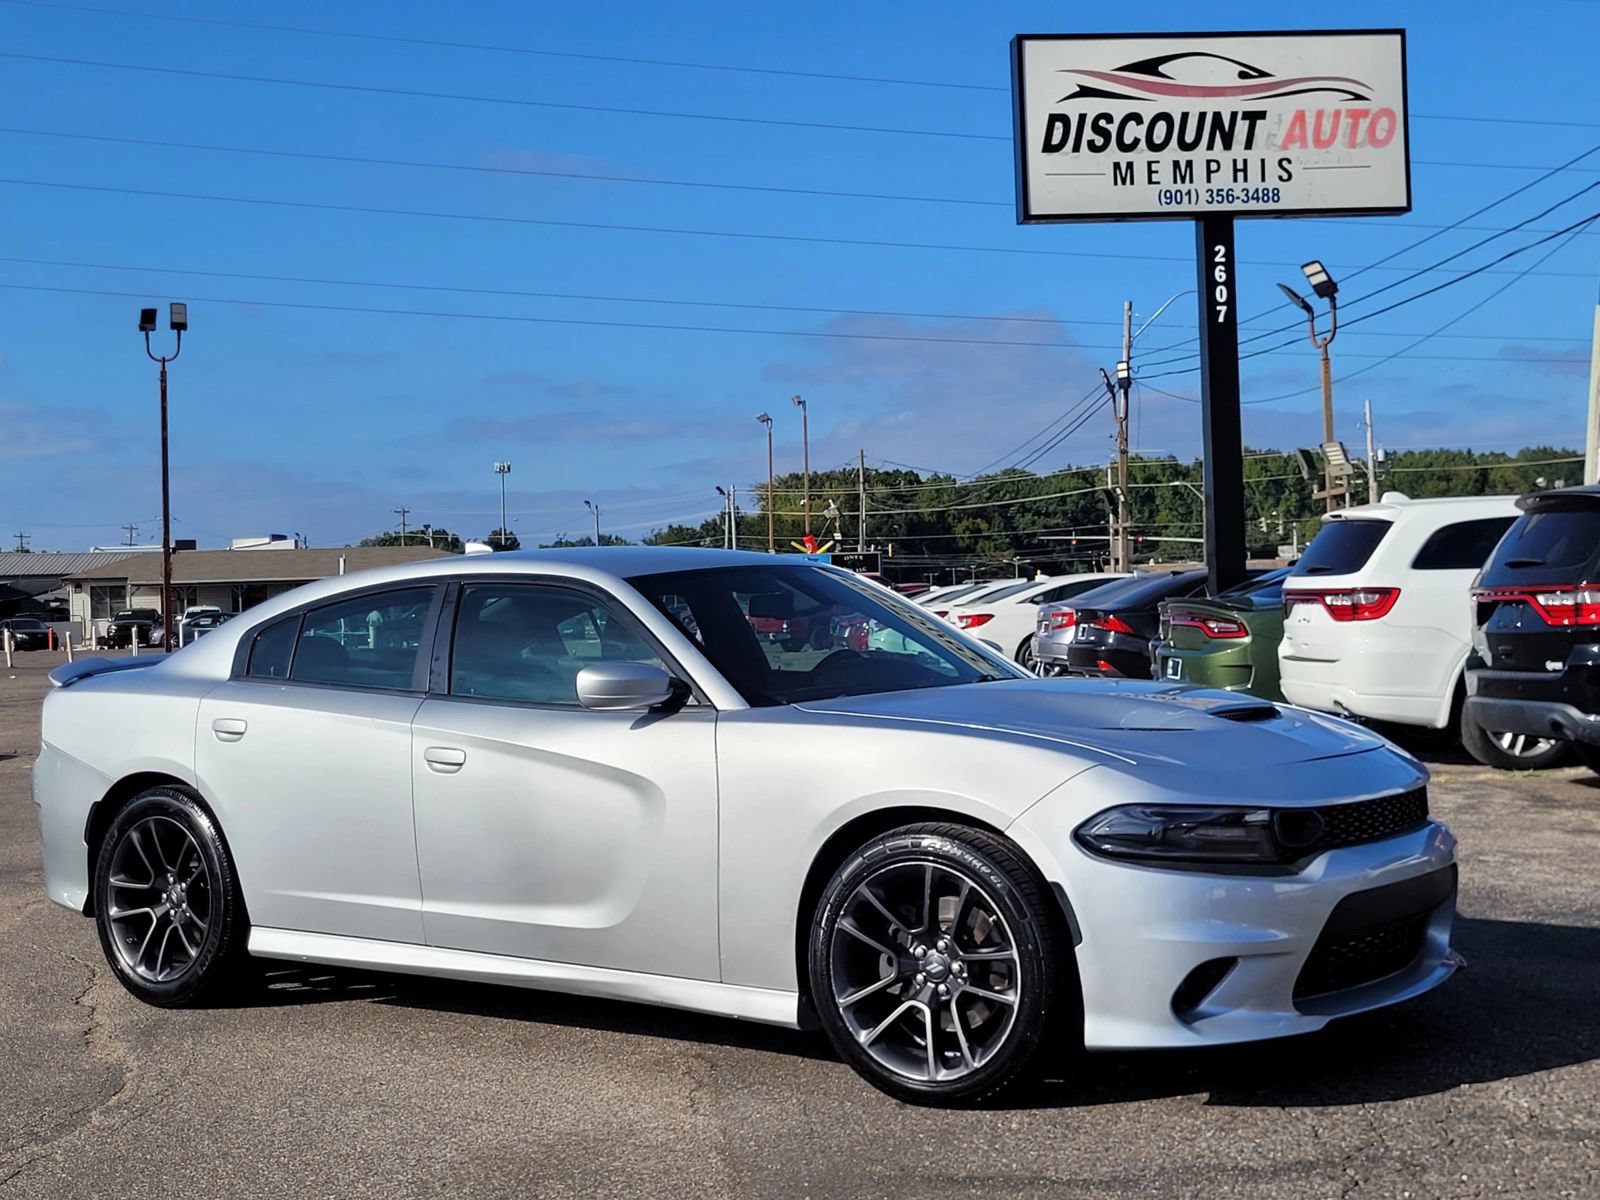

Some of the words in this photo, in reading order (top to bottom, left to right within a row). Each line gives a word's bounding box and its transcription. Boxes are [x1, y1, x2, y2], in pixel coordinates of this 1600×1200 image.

[1041, 110, 1268, 154] DISCOUNT
[1280, 107, 1397, 150] AUTO
[1112, 157, 1293, 186] MEMPHIS
[1157, 188, 1200, 207] (901)
[1205, 187, 1281, 205] 356-3488
[1213, 244, 1228, 323] 2607
